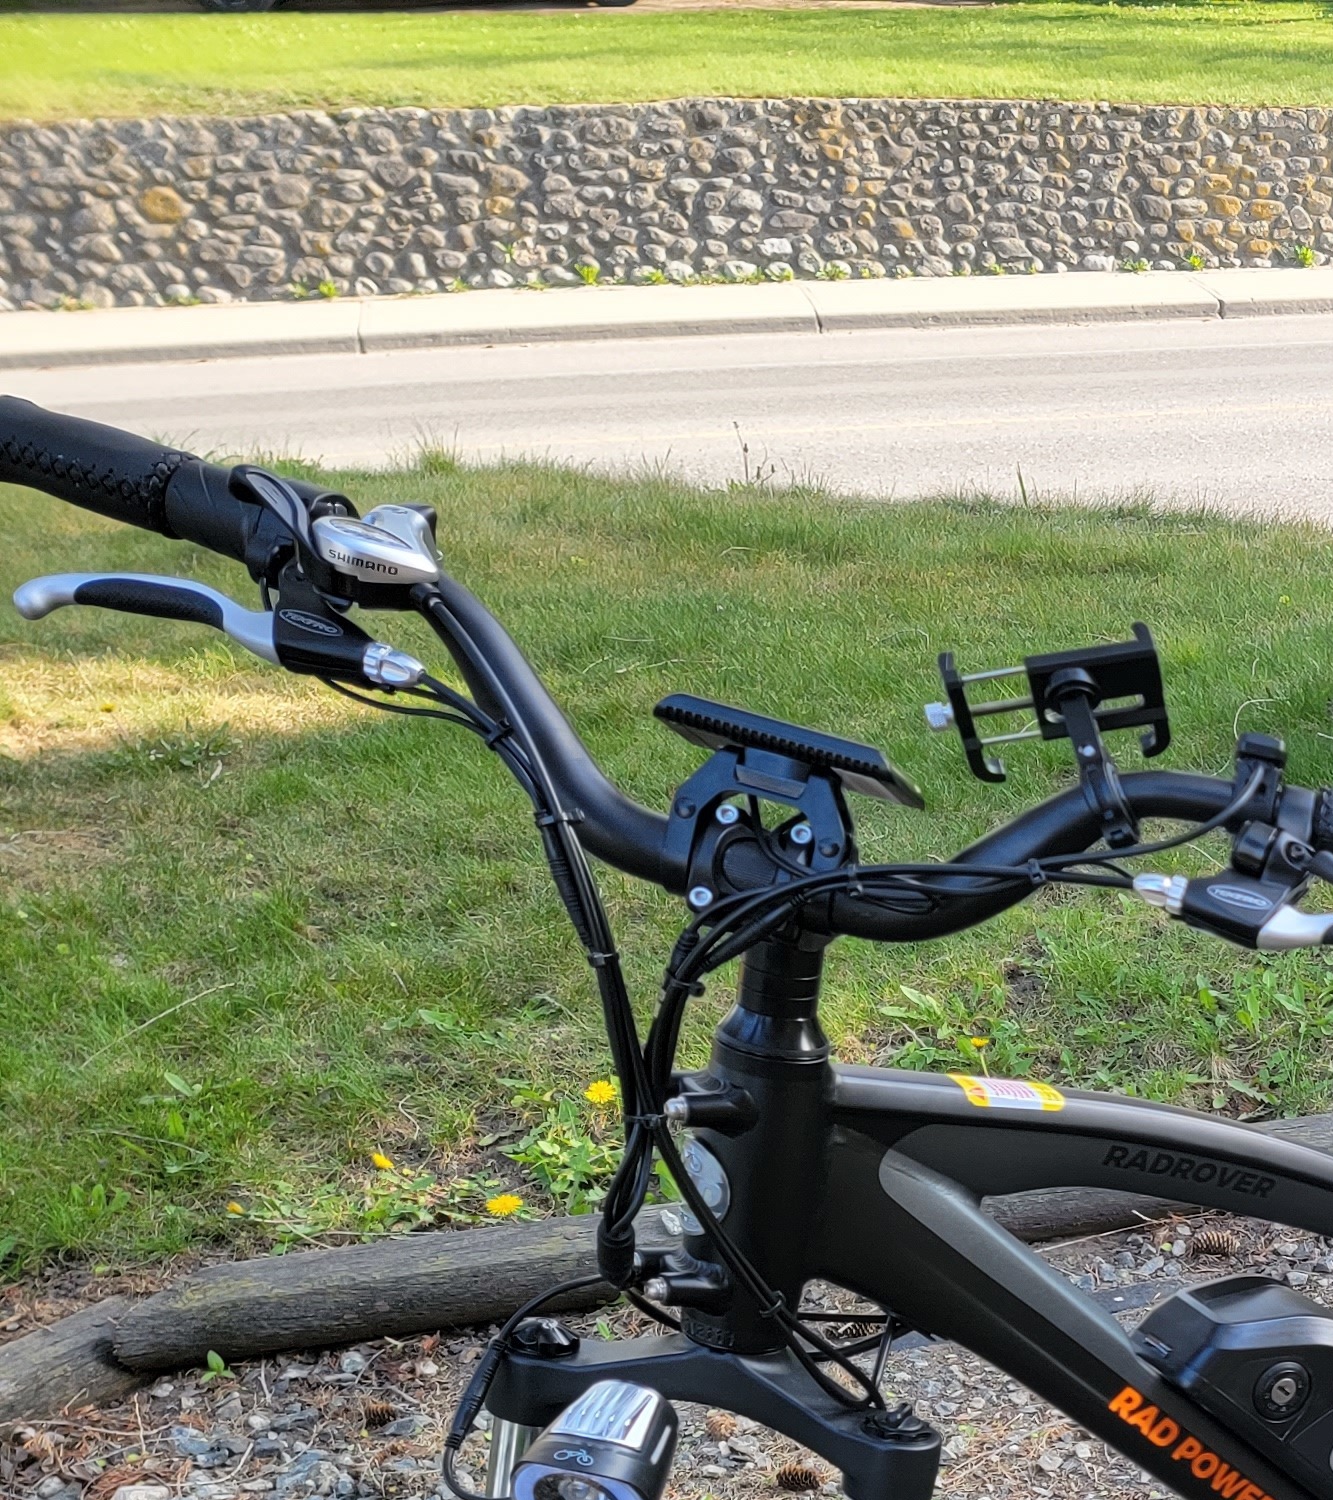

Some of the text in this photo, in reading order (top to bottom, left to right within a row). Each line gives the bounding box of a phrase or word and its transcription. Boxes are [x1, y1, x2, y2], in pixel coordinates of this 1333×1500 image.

[328, 548, 399, 576] SHIMANO
[1102, 1145, 1277, 1199] RADROVER
[1107, 1386, 1181, 1448] RAD
